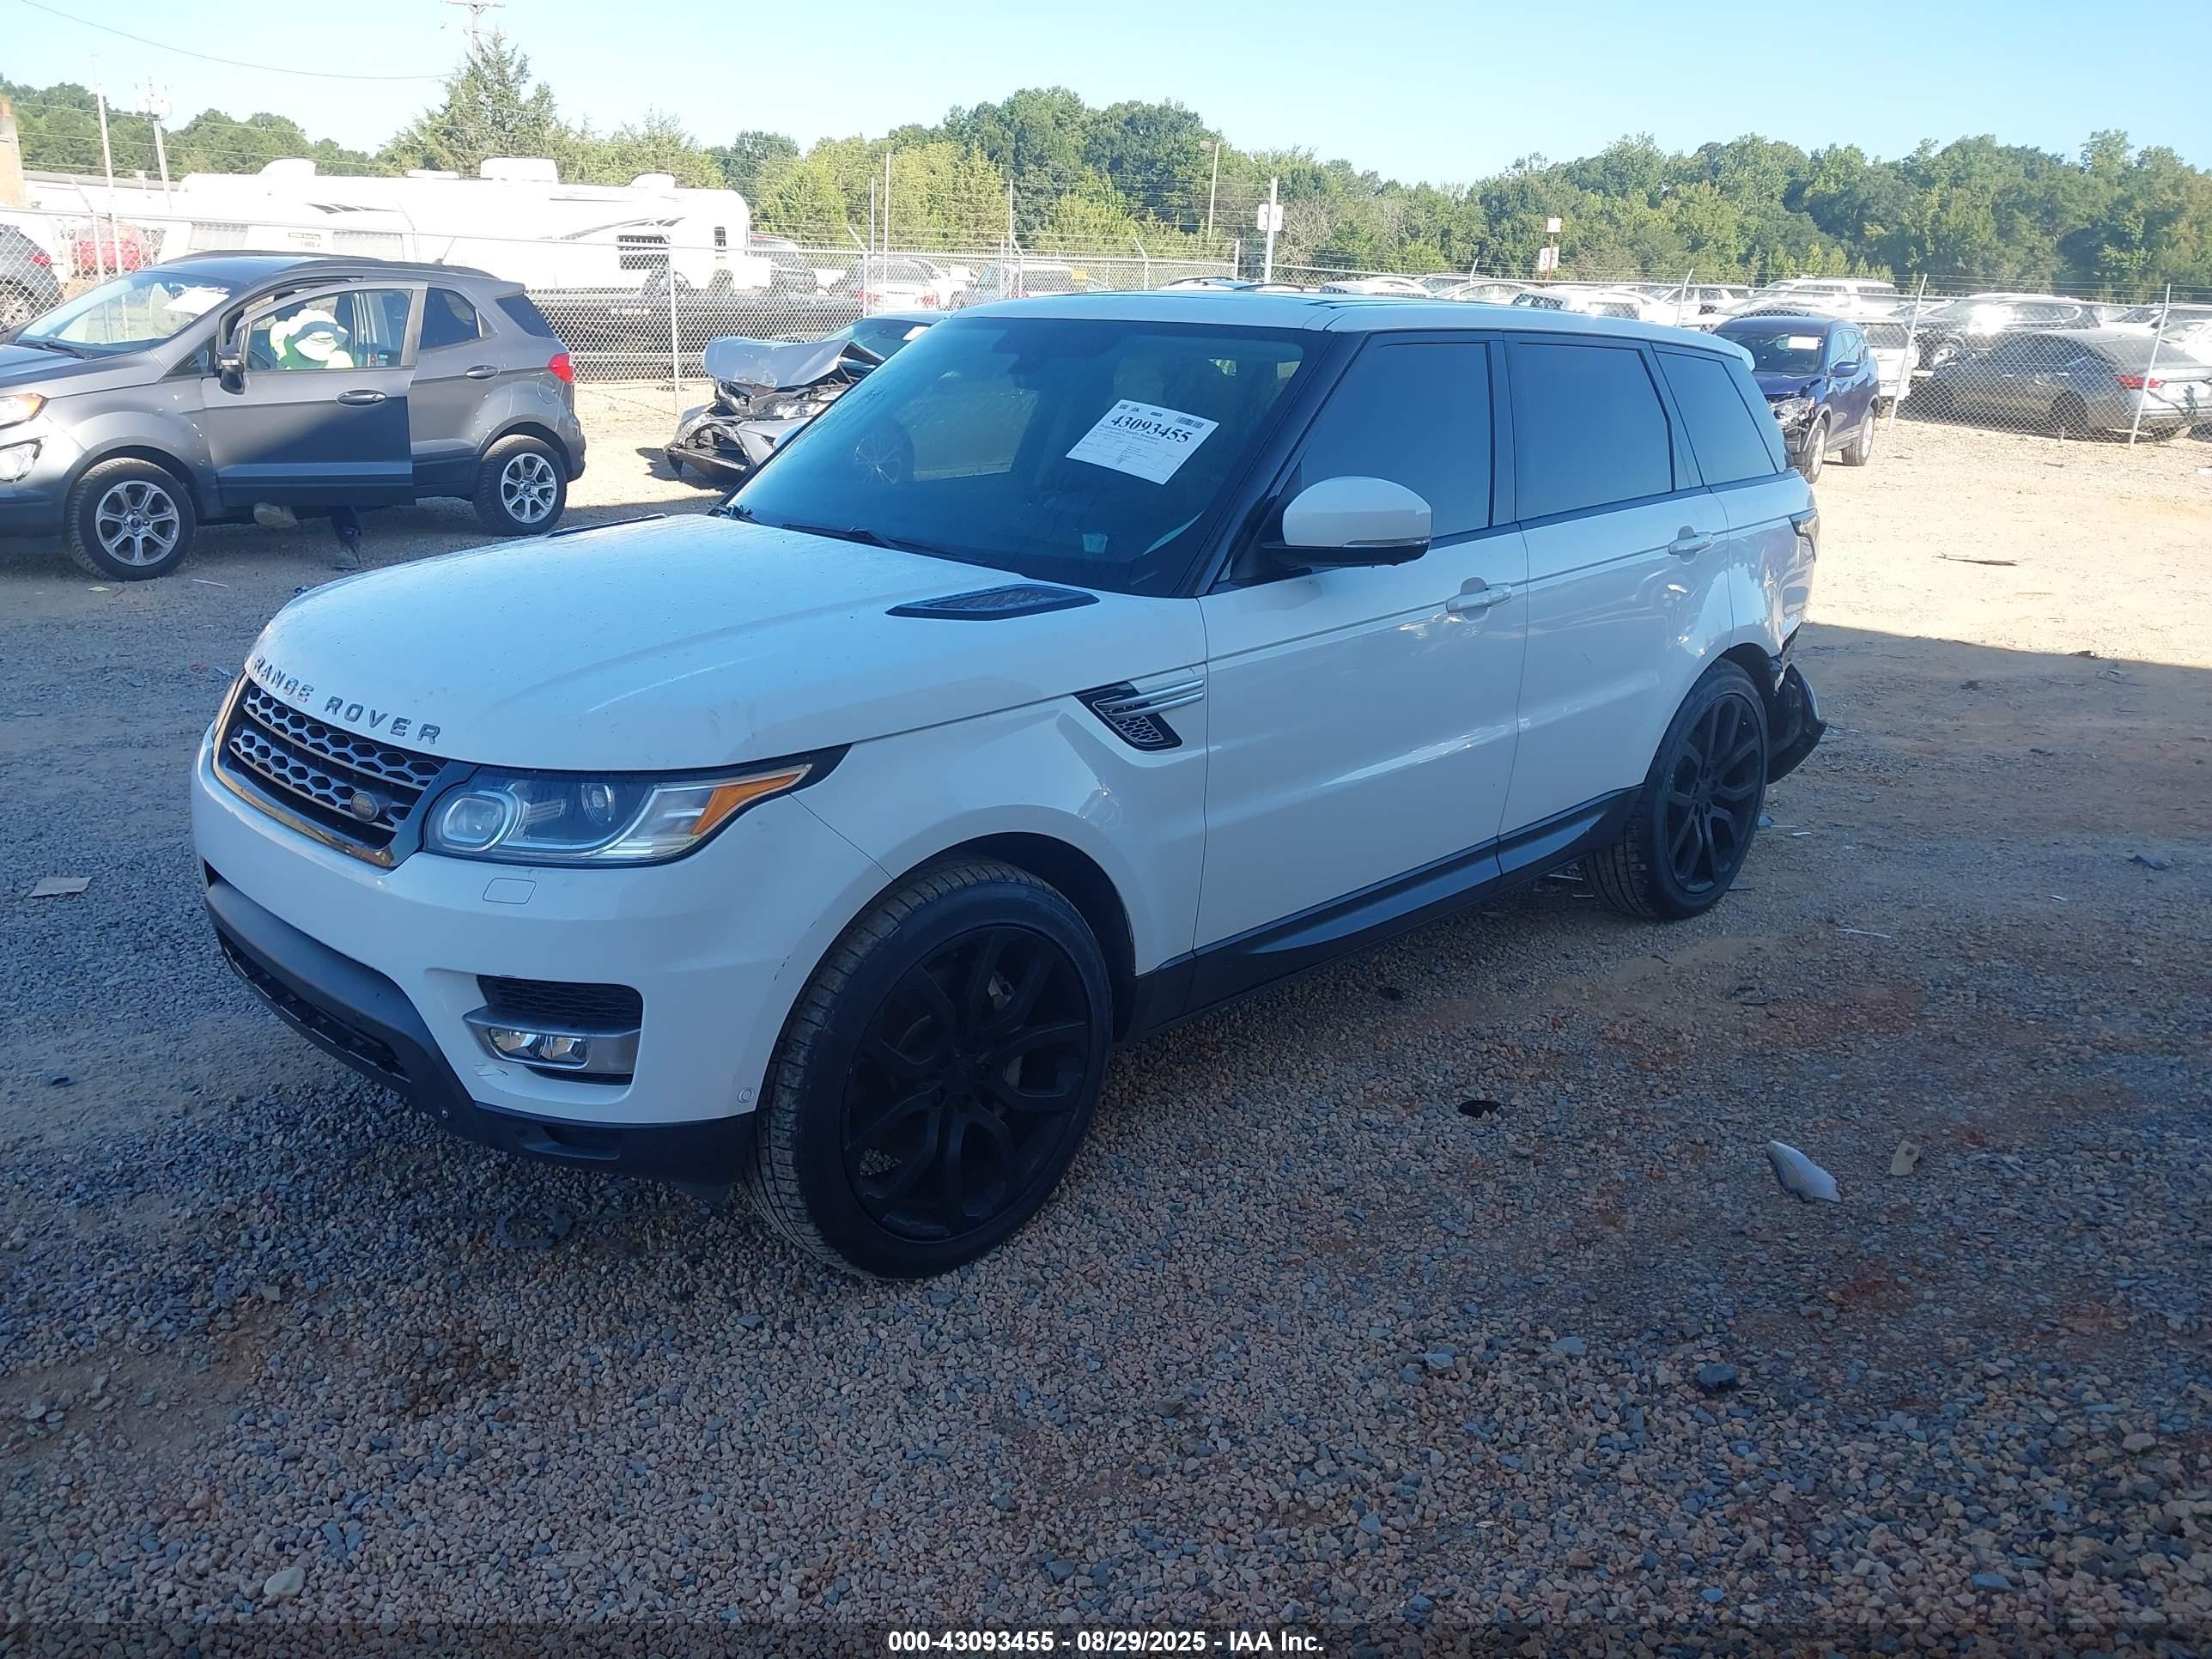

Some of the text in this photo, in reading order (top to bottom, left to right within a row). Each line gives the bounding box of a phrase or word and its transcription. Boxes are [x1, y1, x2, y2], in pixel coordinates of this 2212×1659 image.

[1110, 415, 1194, 443] 43093455
[253, 658, 441, 744] RANGE ROVER
